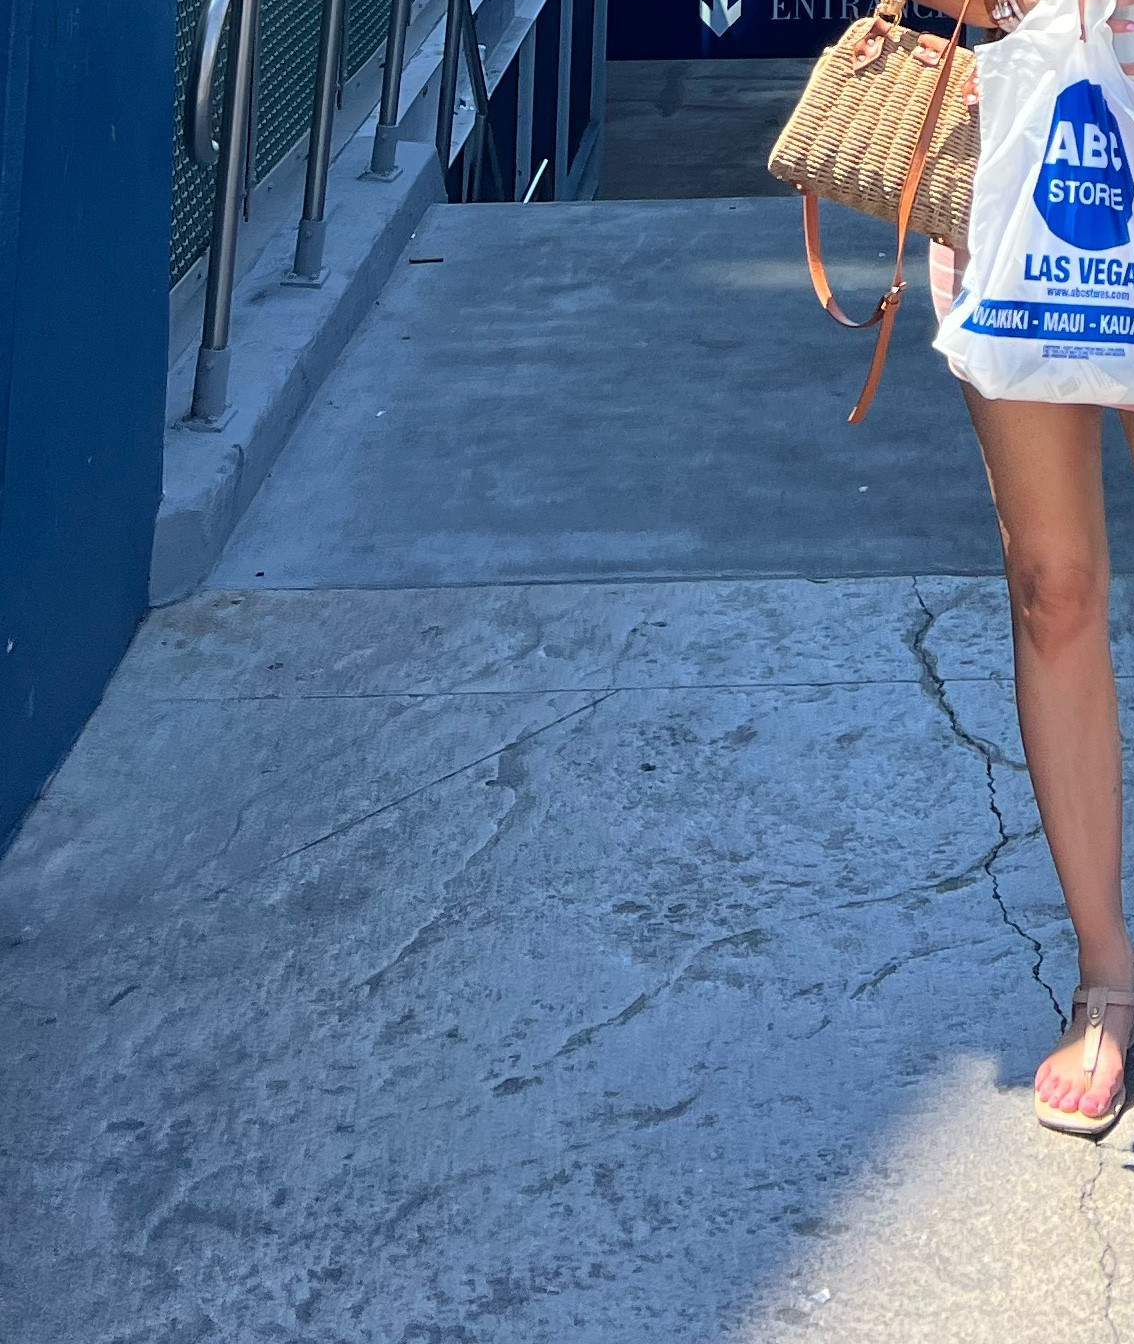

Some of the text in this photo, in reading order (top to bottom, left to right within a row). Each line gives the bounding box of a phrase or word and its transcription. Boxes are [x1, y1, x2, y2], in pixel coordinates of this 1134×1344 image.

[1049, 179, 1124, 211] STORE
[1024, 254, 1070, 283] LAS
[972, 306, 1029, 330] WAIKIKI
[1043, 312, 1084, 333] MAUI
